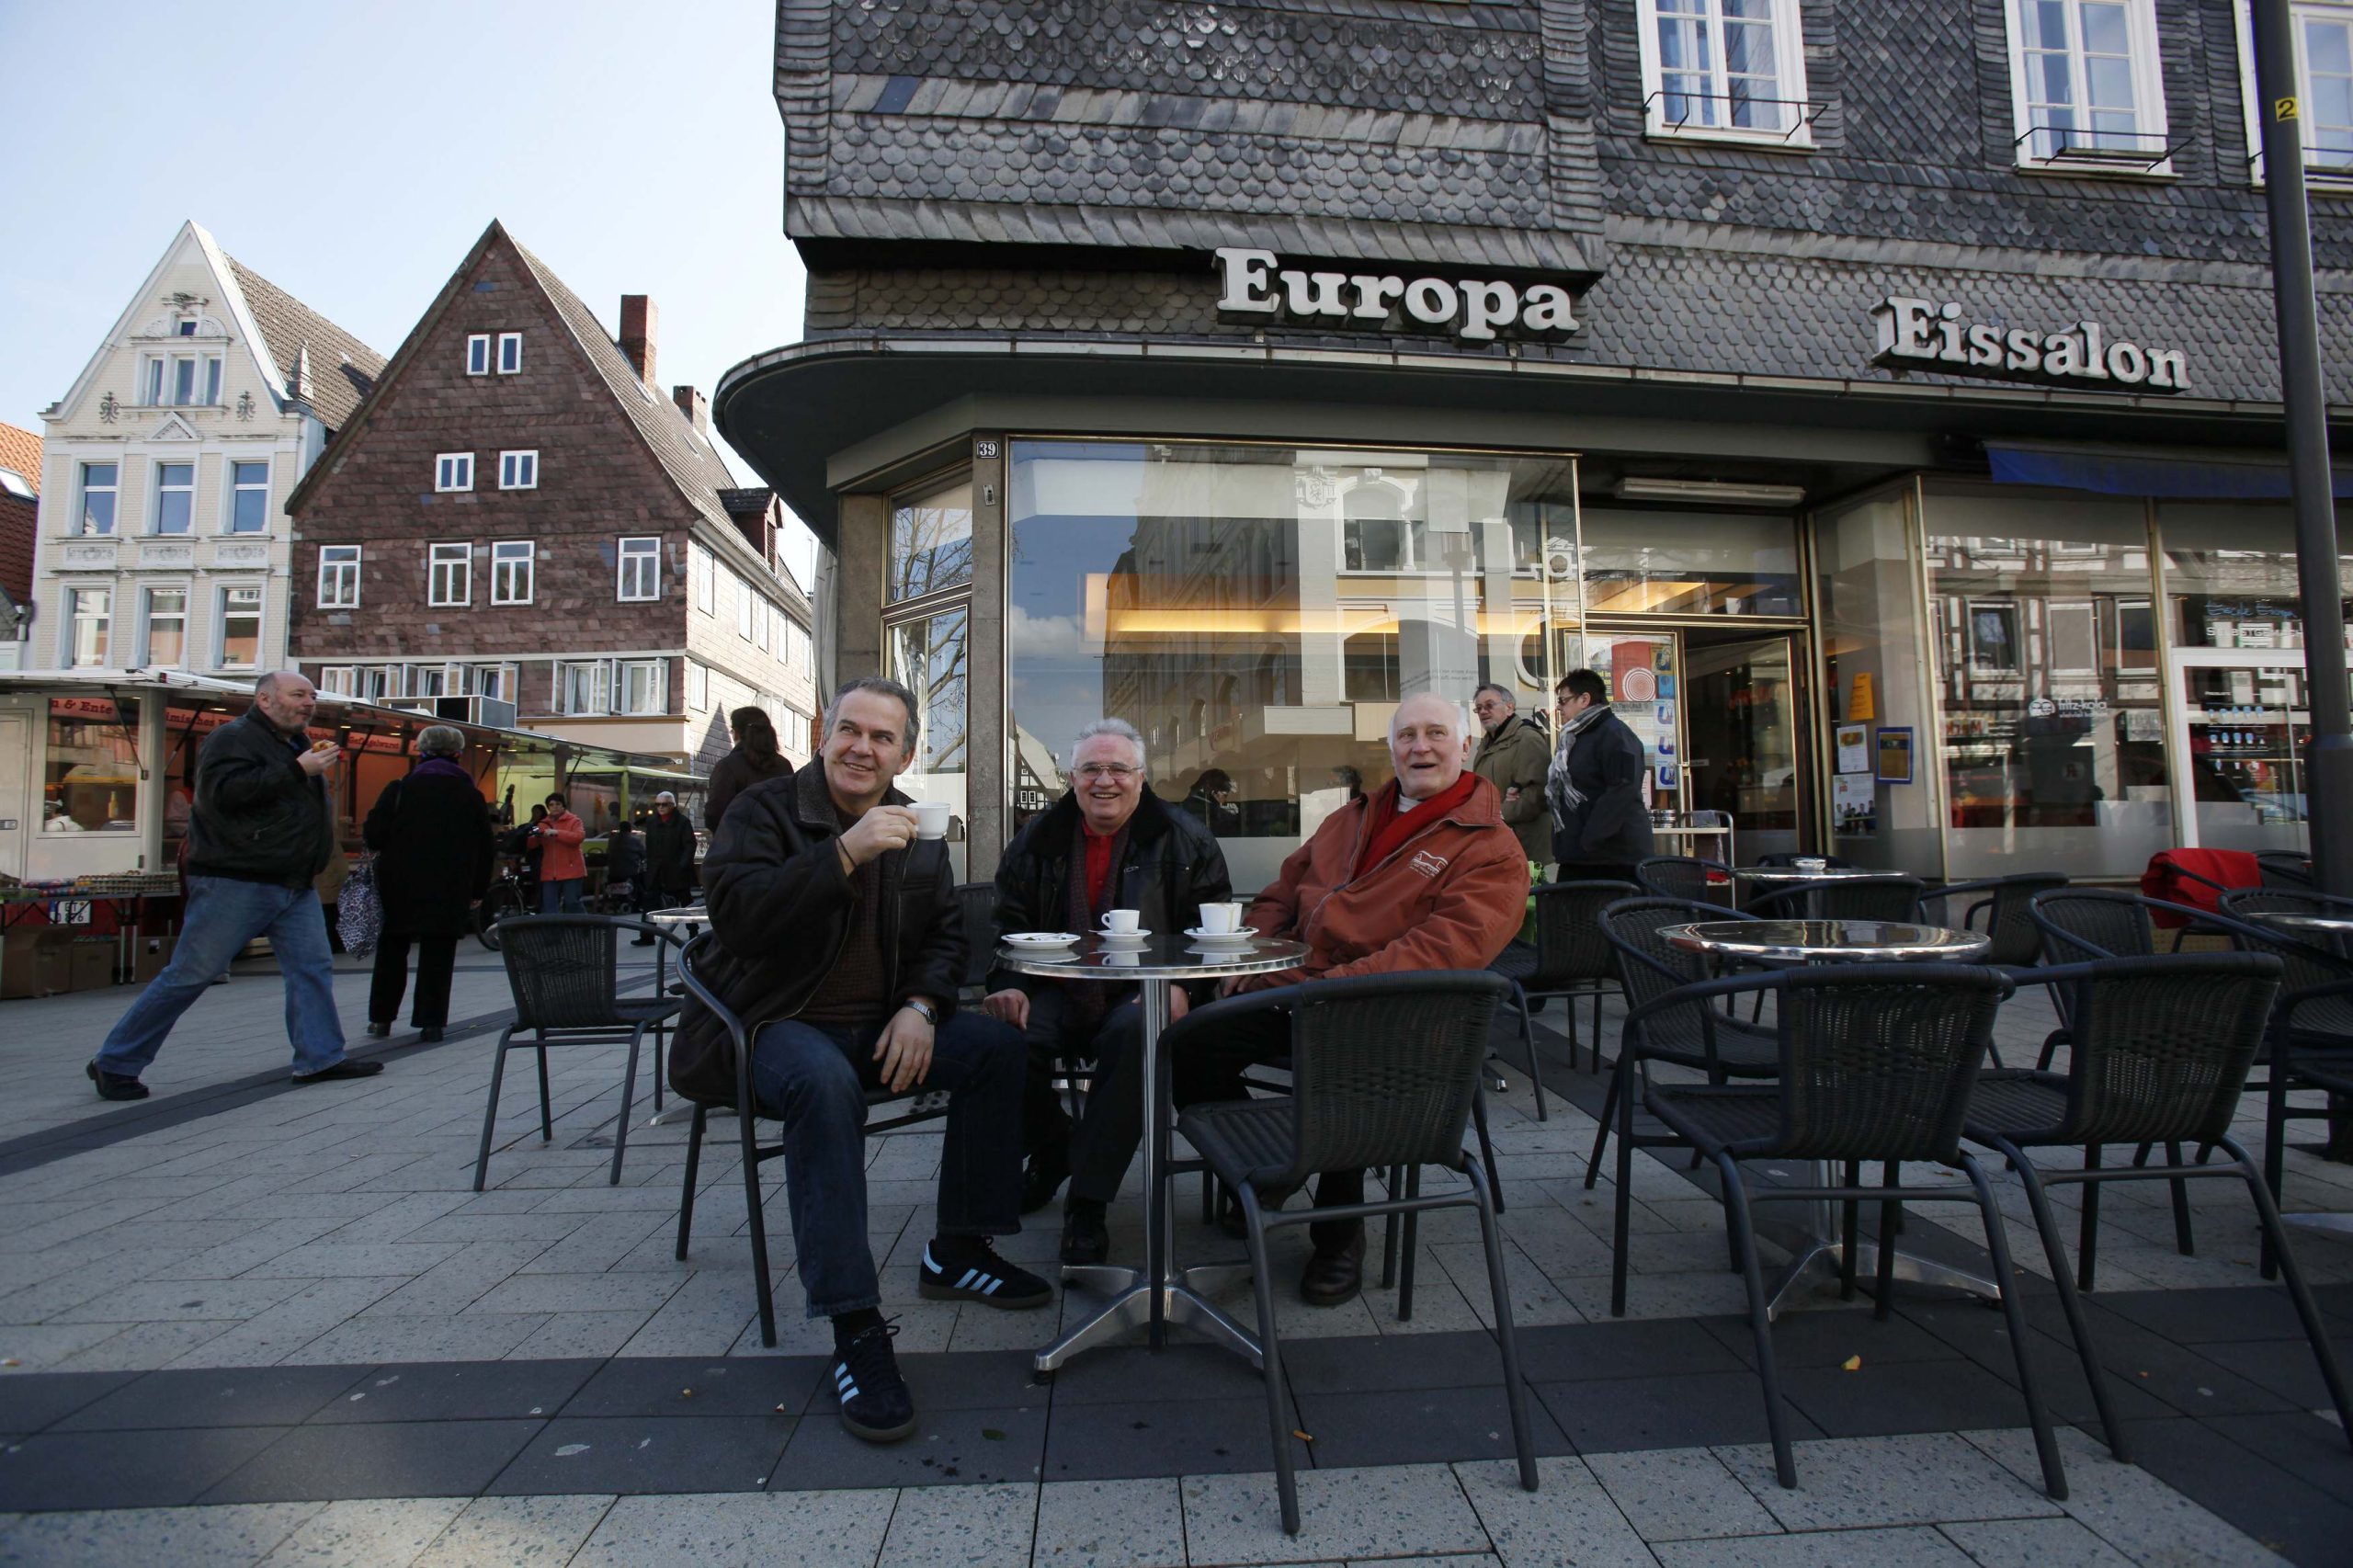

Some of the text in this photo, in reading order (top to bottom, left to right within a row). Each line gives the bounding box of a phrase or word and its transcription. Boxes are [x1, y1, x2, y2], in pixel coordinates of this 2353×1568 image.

[2278, 99, 2296, 119] 2
[1214, 245, 1581, 341] Europa
[1884, 295, 2193, 390] Eissalon
[979, 442, 996, 457] 39
[64, 699, 76, 710] &
[79, 700, 113, 715] Ente
[2058, 698, 2108, 710] fritz-kola
